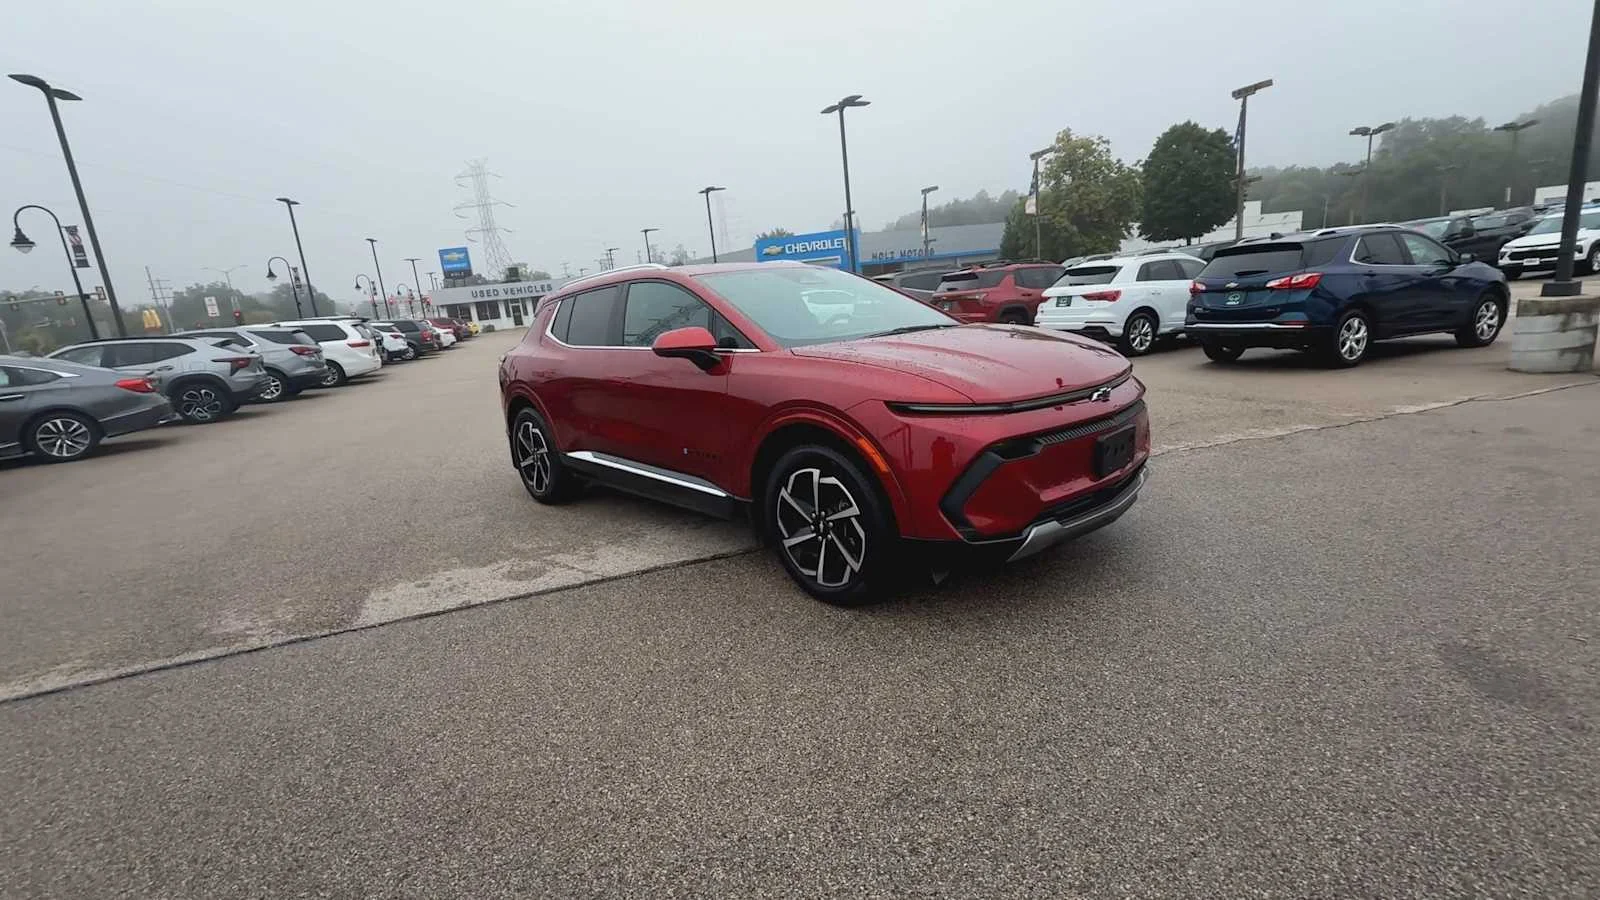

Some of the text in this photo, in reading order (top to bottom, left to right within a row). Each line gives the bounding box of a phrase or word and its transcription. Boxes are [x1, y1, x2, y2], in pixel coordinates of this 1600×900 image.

[785, 237, 848, 255] CHEVROLET
[471, 284, 553, 298] USED VEHICLES
